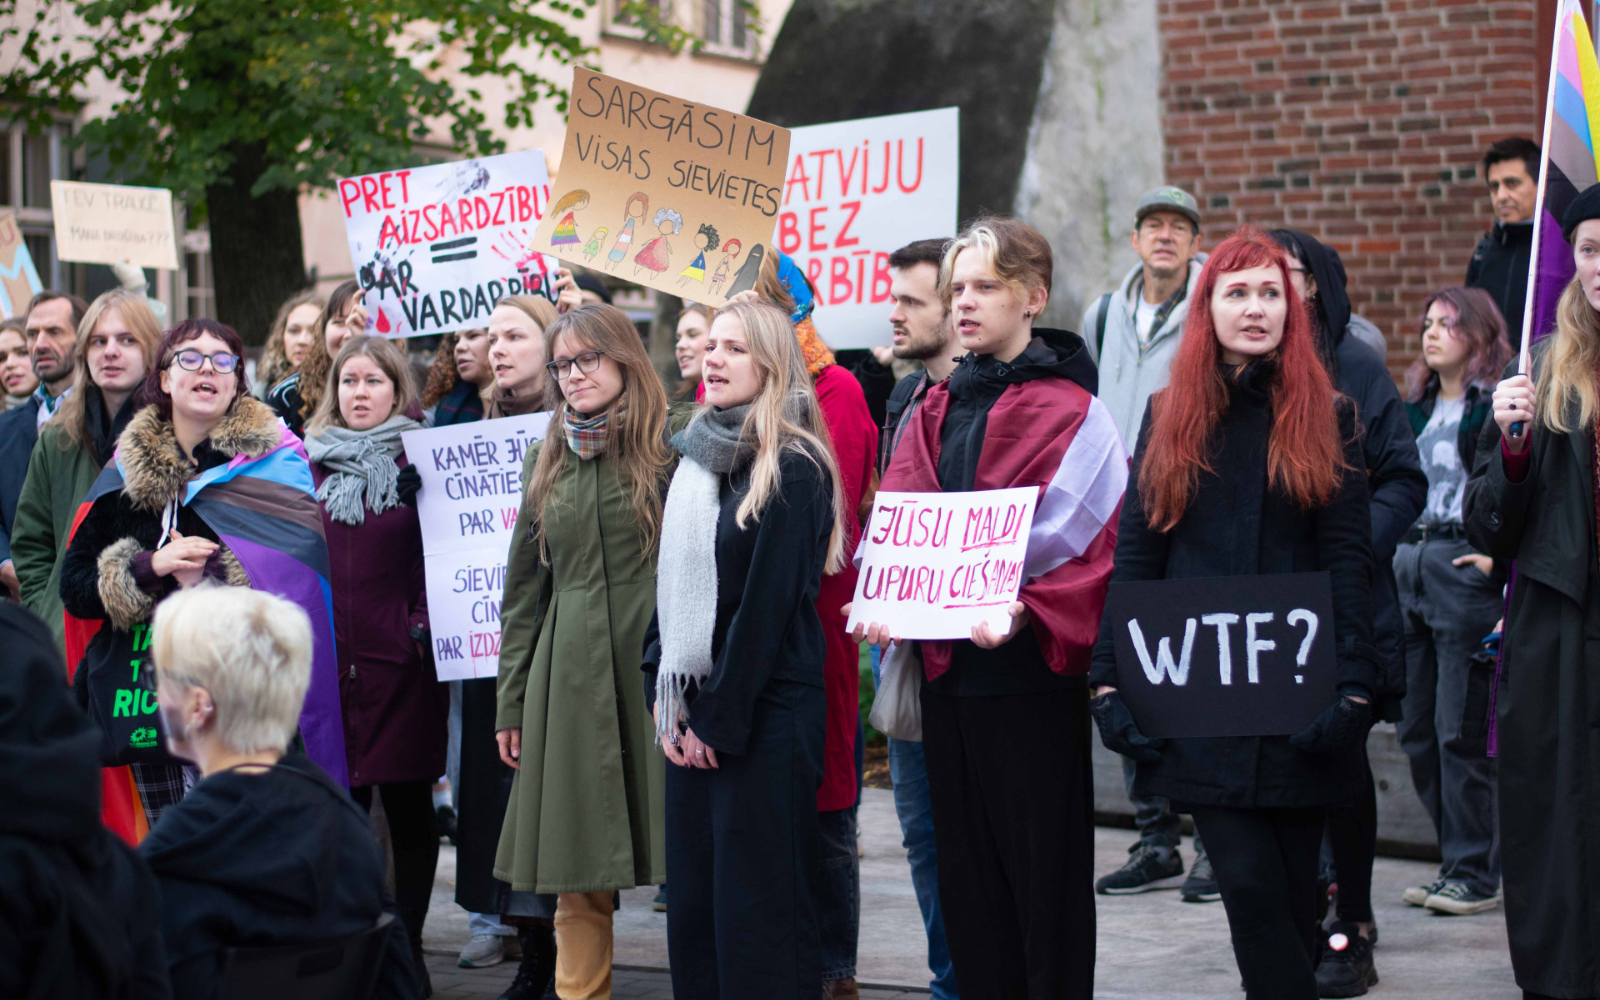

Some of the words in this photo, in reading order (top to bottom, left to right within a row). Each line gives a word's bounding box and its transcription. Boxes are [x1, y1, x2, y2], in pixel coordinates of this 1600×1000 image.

[577, 77, 774, 166] SARGĀSIM
[339, 171, 411, 218] PRET
[576, 132, 651, 180] VISAS
[667, 159, 781, 217] SIEVIETES
[785, 137, 923, 205] ATVIJU
[379, 184, 550, 250] AIZSARDZĪBU
[779, 201, 861, 255] BEZ
[360, 260, 419, 305] PAR
[807, 250, 894, 306] RBĪB
[432, 435, 500, 471] KAMĒR
[505, 430, 538, 464] JŪ
[459, 509, 495, 536] PAR
[500, 507, 518, 530] VA
[872, 500, 954, 548] JŪSU
[962, 503, 1027, 546] MALDI
[862, 565, 945, 604] UPURU
[471, 595, 502, 624] CĪN
[131, 623, 156, 651] TA
[436, 635, 465, 661] PAR
[468, 630, 503, 658] IZDZ
[1127, 608, 1319, 686] WTF?
[113, 688, 160, 718] RIC
